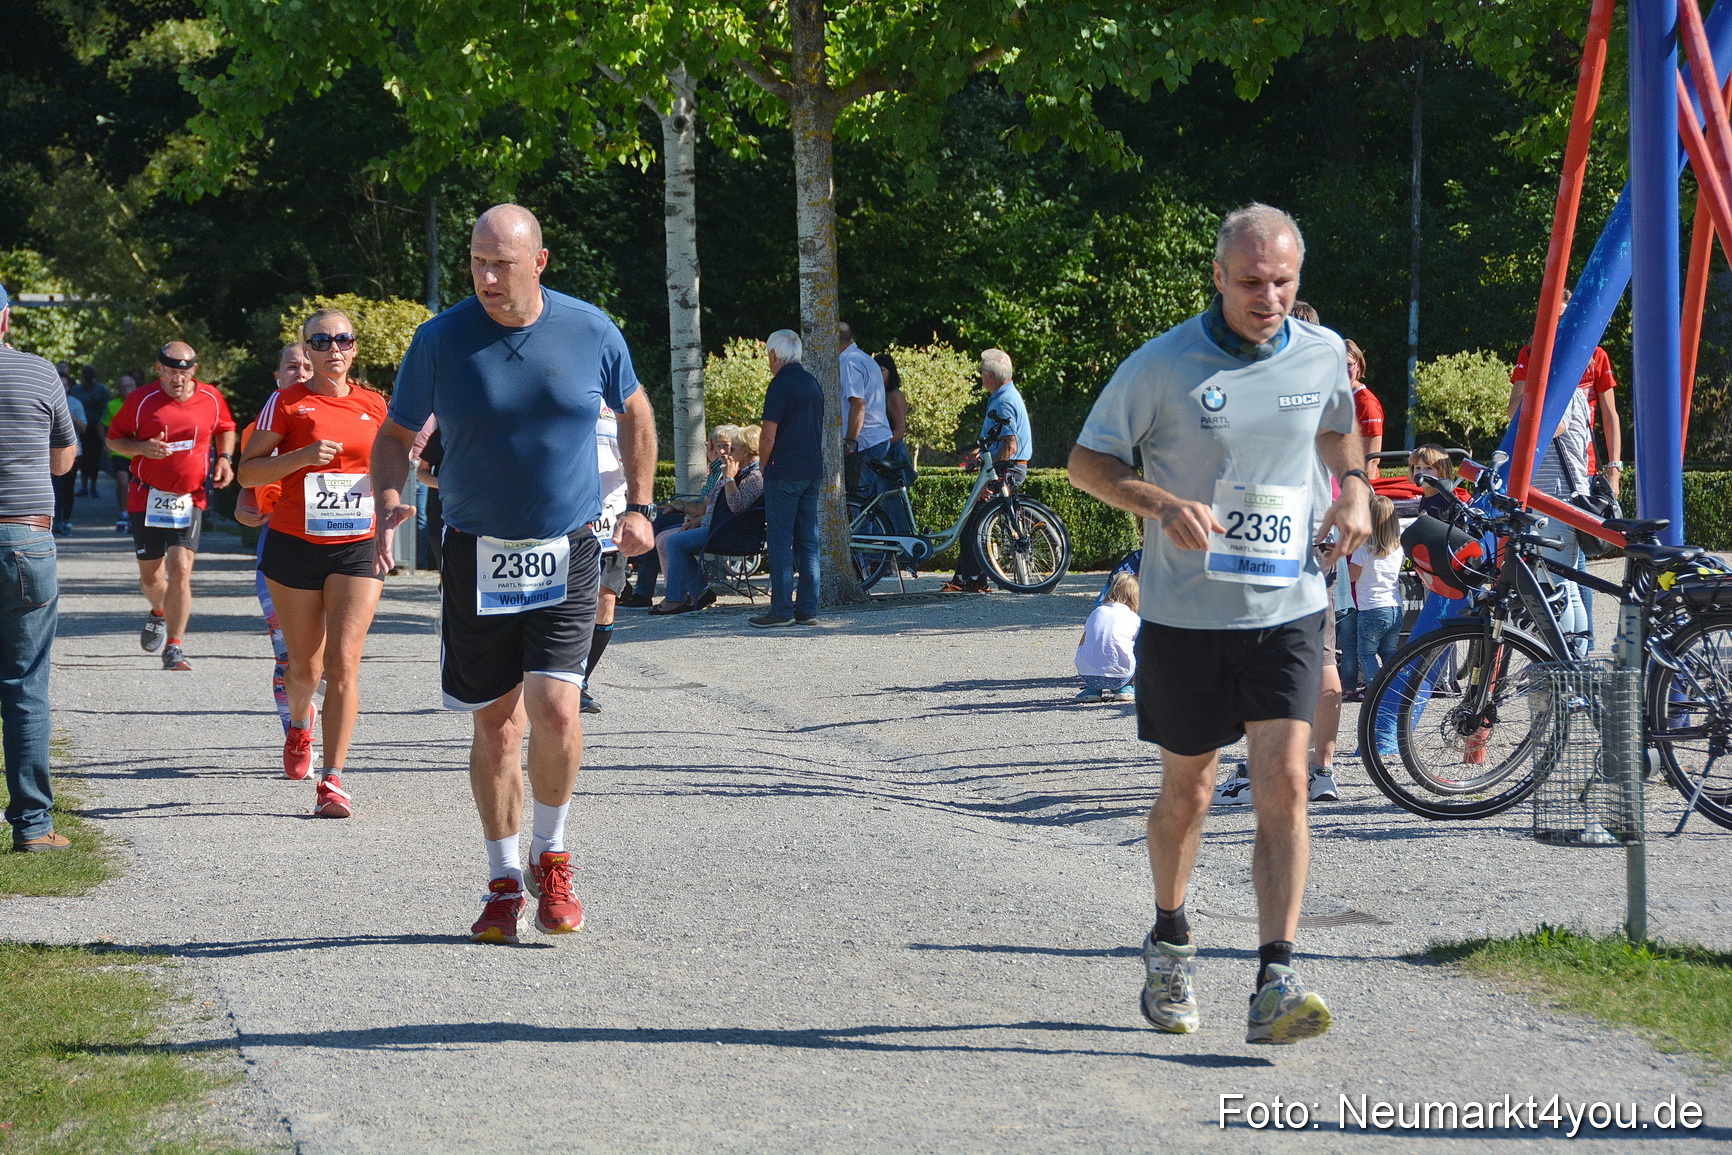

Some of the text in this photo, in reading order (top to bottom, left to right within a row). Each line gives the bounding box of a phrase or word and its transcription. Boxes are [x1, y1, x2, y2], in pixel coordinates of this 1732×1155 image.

[1279, 393, 1320, 407] BOCK
[1200, 416, 1230, 424] PARTL
[154, 497, 185, 510] 2434
[316, 491, 362, 509] 2217
[1243, 493, 1284, 506] BOCK
[327, 521, 354, 529] Denisa
[593, 517, 611, 533] 04
[1225, 511, 1291, 544] 2336
[1230, 544, 1251, 552] PARTL
[491, 552, 556, 579] 2380
[1239, 559, 1275, 574] Martin
[500, 592, 549, 606] Wolfgang
